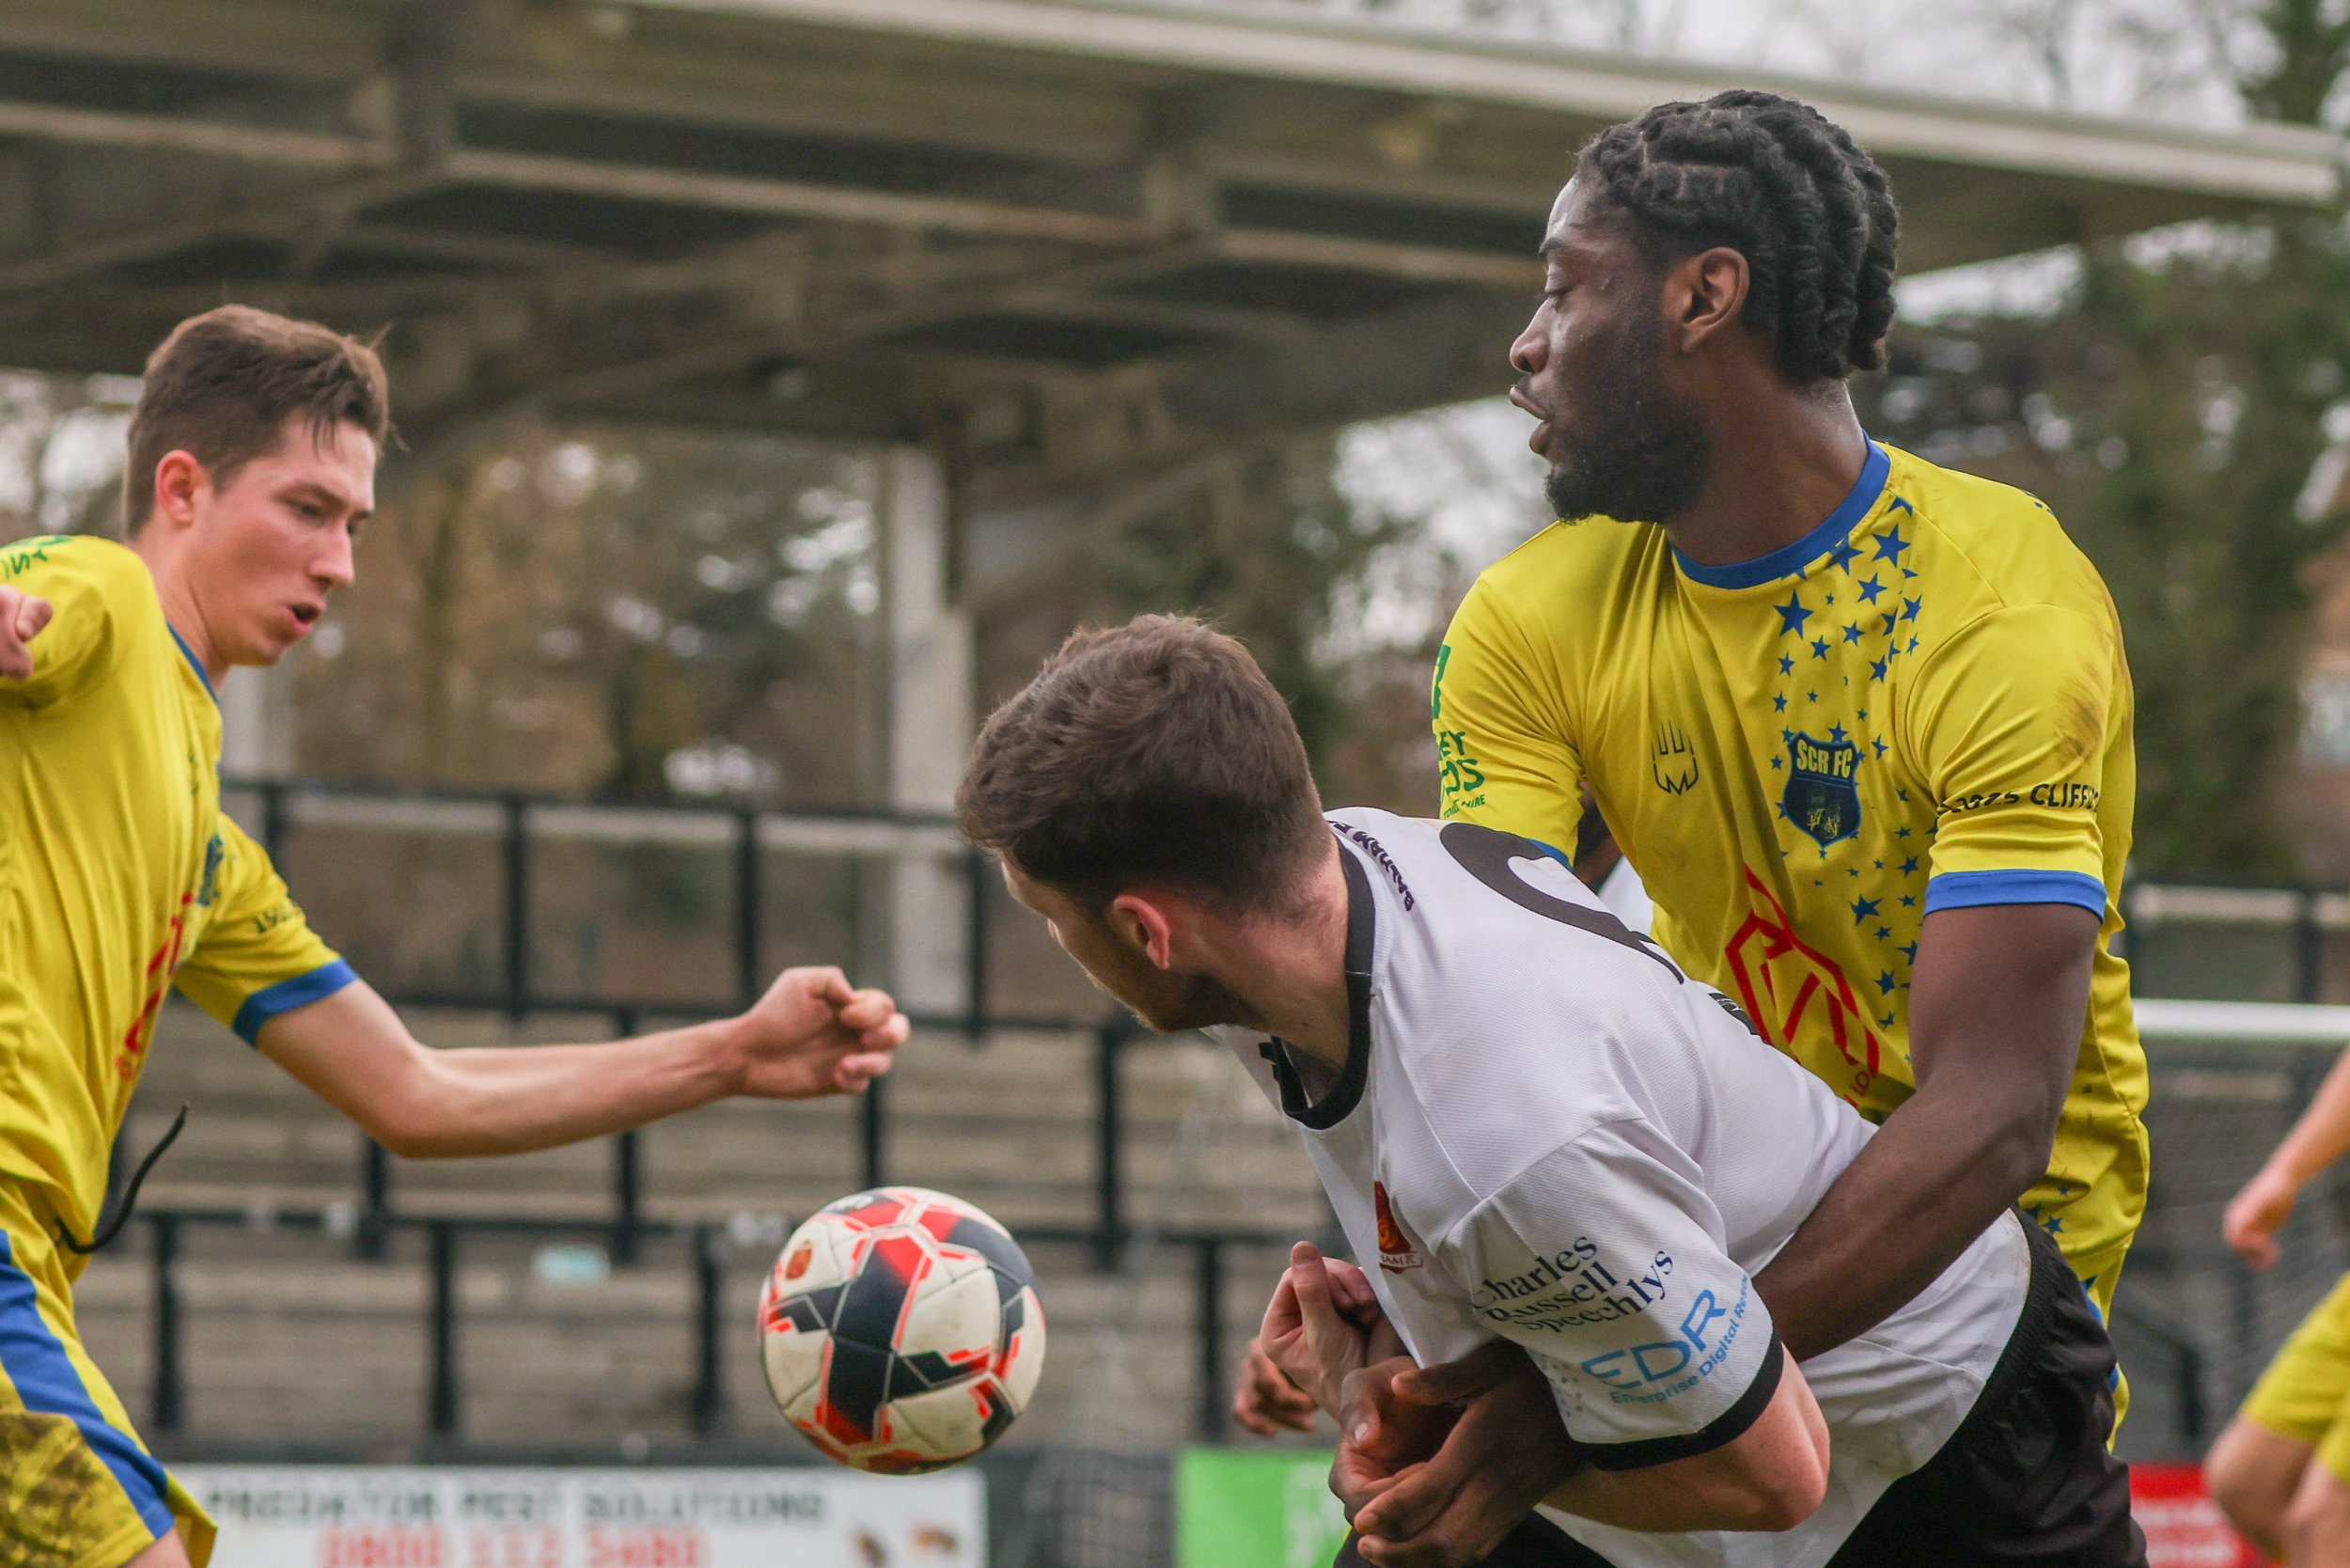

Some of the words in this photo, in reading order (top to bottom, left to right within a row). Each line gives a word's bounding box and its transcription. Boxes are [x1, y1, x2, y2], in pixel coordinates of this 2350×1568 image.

[1795, 738, 1830, 775] SCR
[1832, 747, 1854, 778] FC
[1580, 1288, 1727, 1389] EDR
[1608, 1374, 1700, 1404] Enerprise
[1698, 1318, 1740, 1376] Digital
